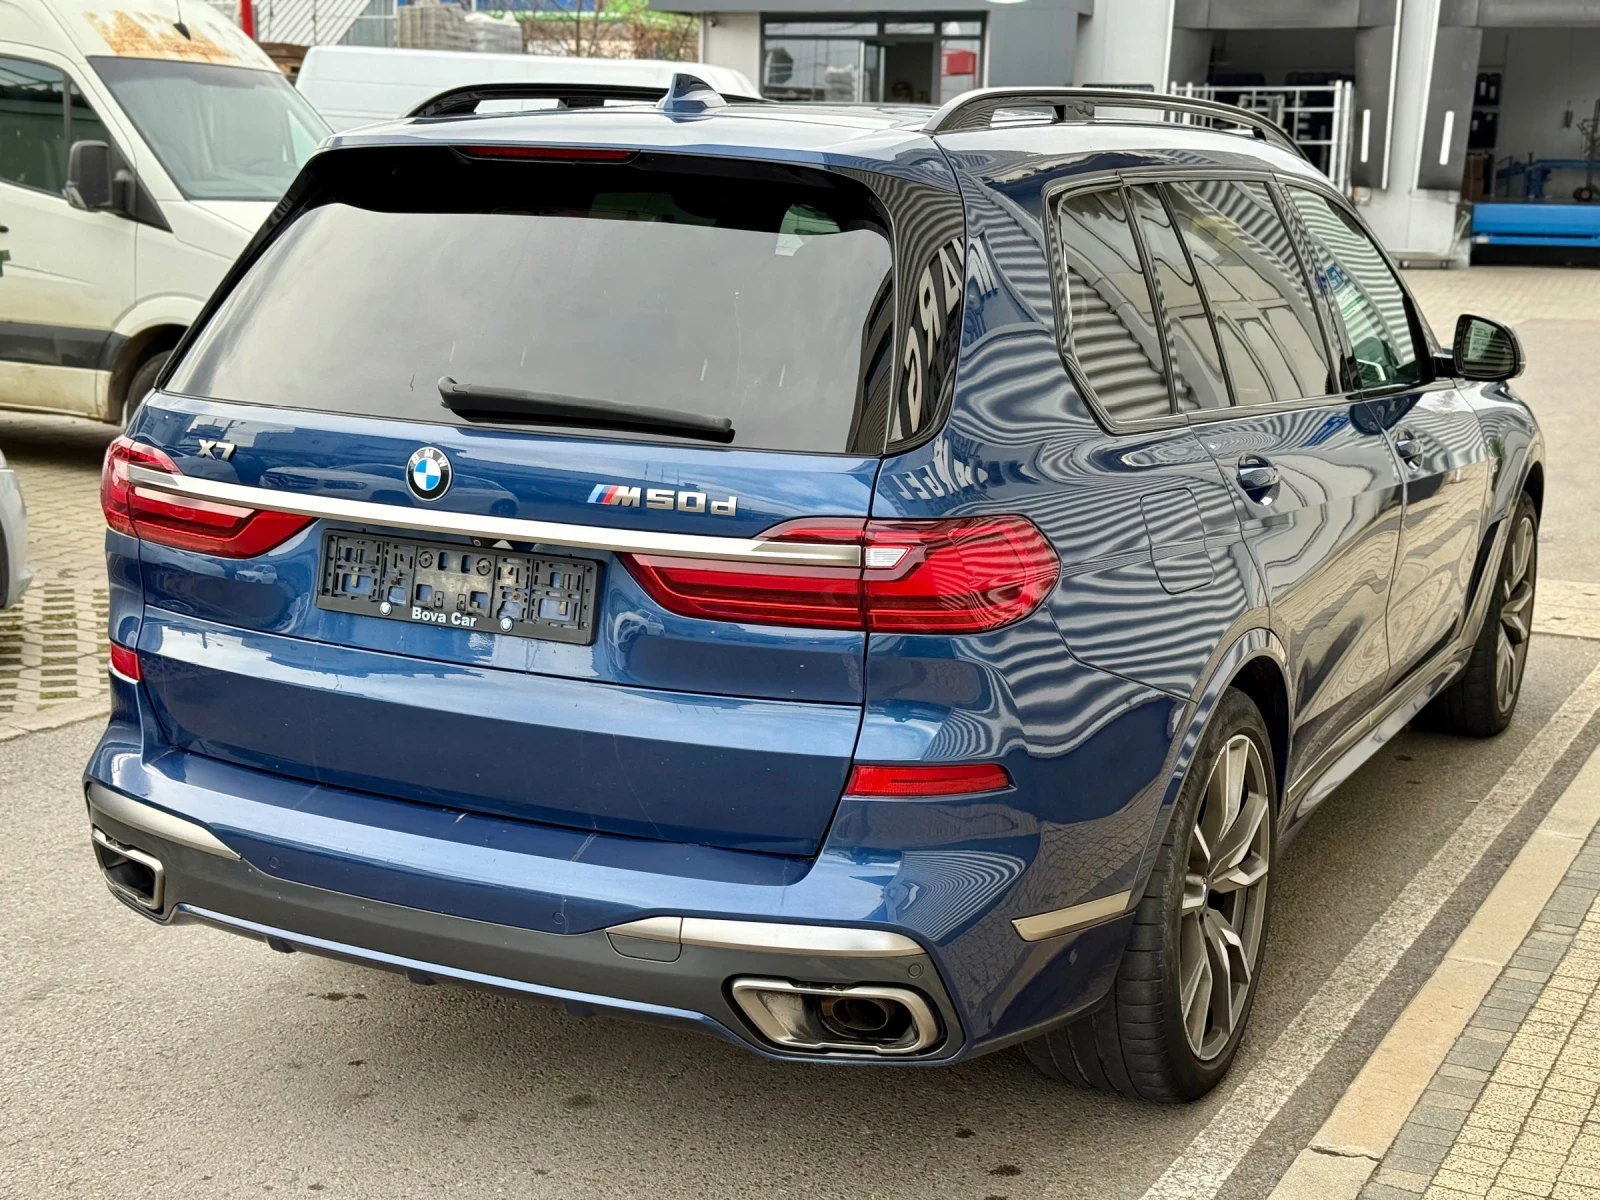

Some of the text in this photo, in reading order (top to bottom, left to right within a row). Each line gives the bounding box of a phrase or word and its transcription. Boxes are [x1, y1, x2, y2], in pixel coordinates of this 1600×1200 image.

[197, 439, 235, 462] X7
[411, 449, 448, 467] BMW
[411, 605, 477, 627] Bova Car
